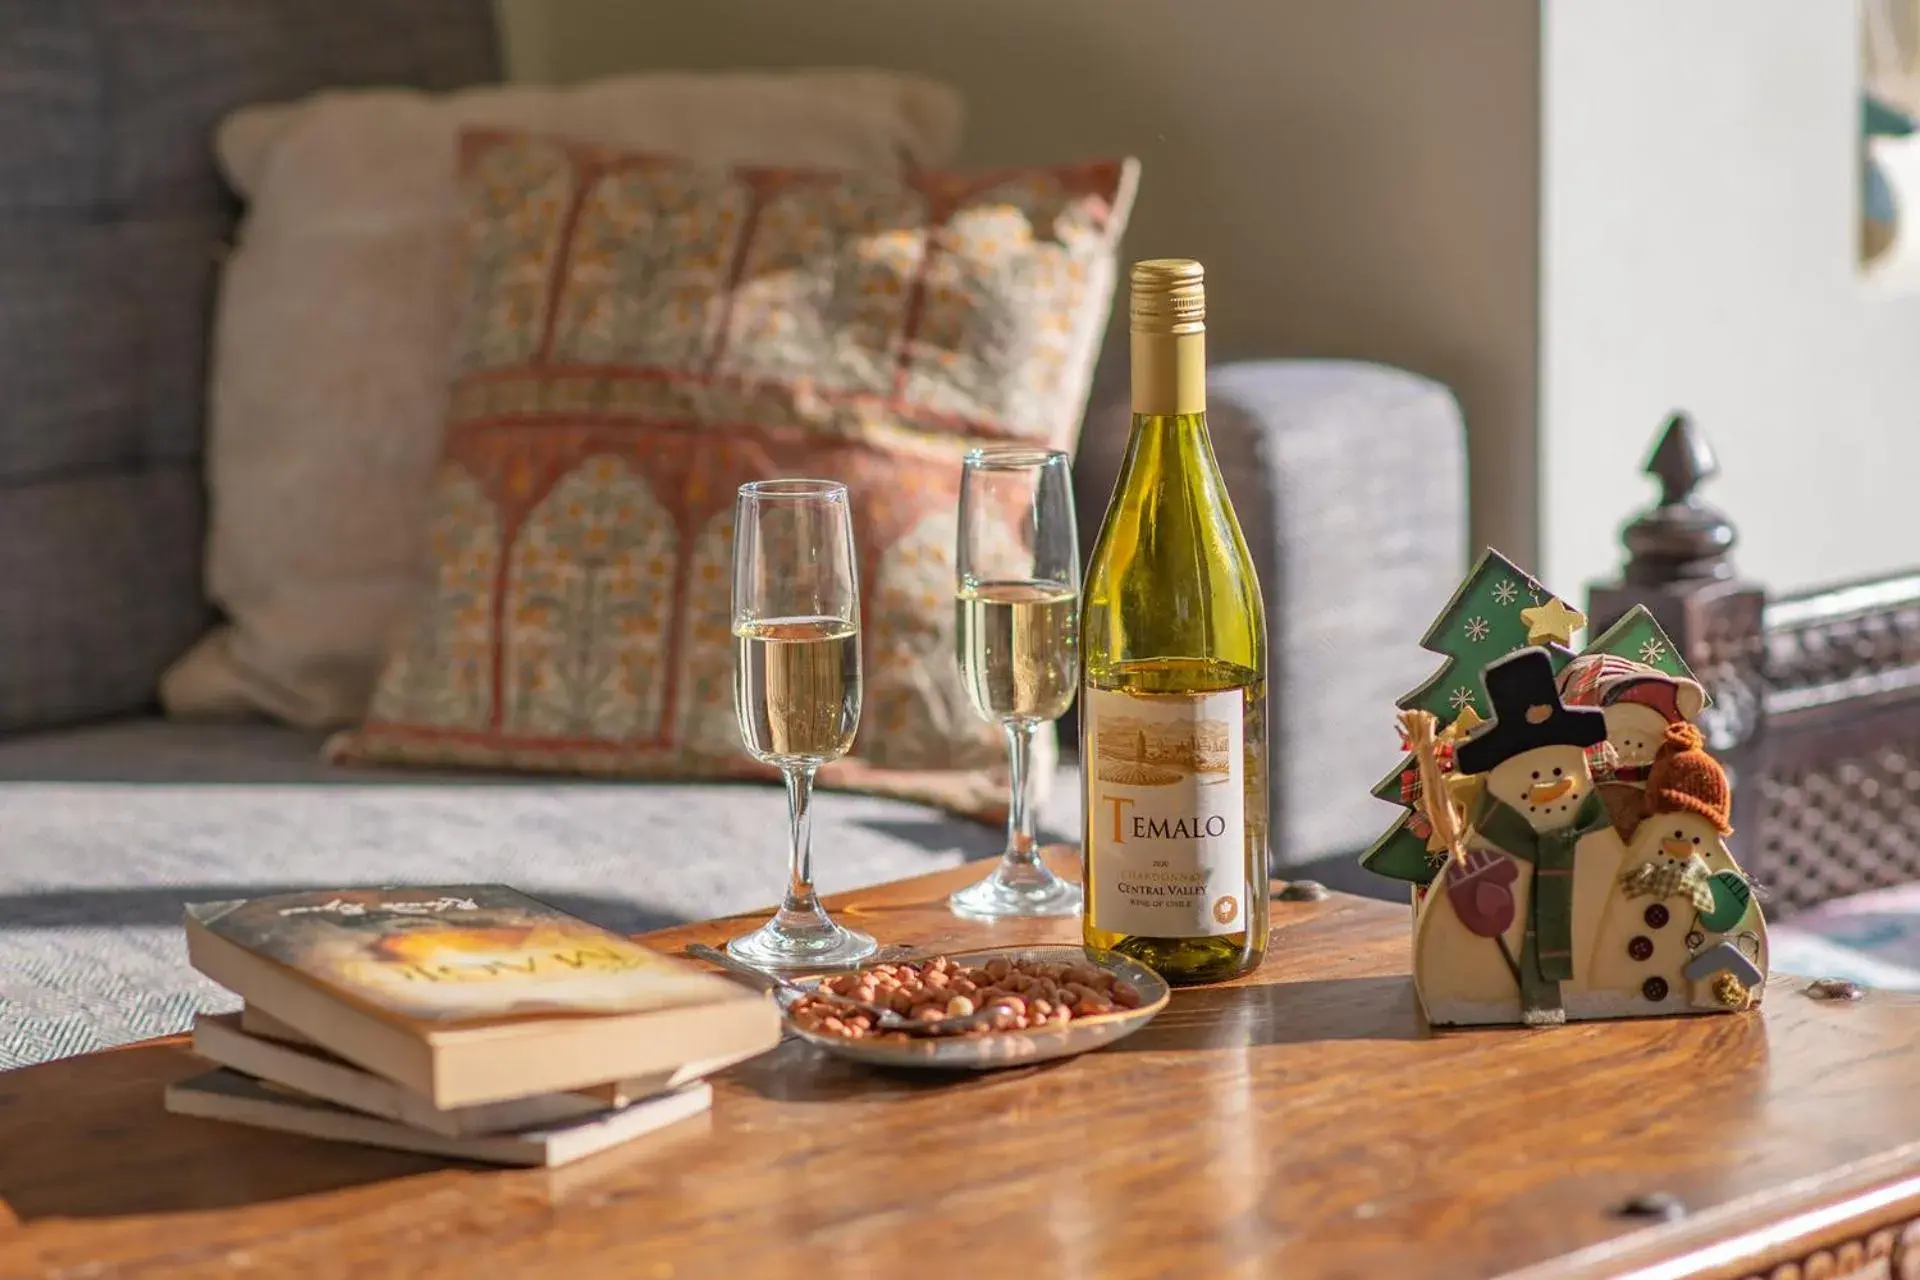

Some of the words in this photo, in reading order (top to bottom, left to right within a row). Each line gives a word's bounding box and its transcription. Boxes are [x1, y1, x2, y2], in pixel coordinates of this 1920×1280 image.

[1102, 794, 1226, 844] TEMALO
[1118, 882, 1164, 896] CENTRAL
[1167, 884, 1208, 896] VALLEY
